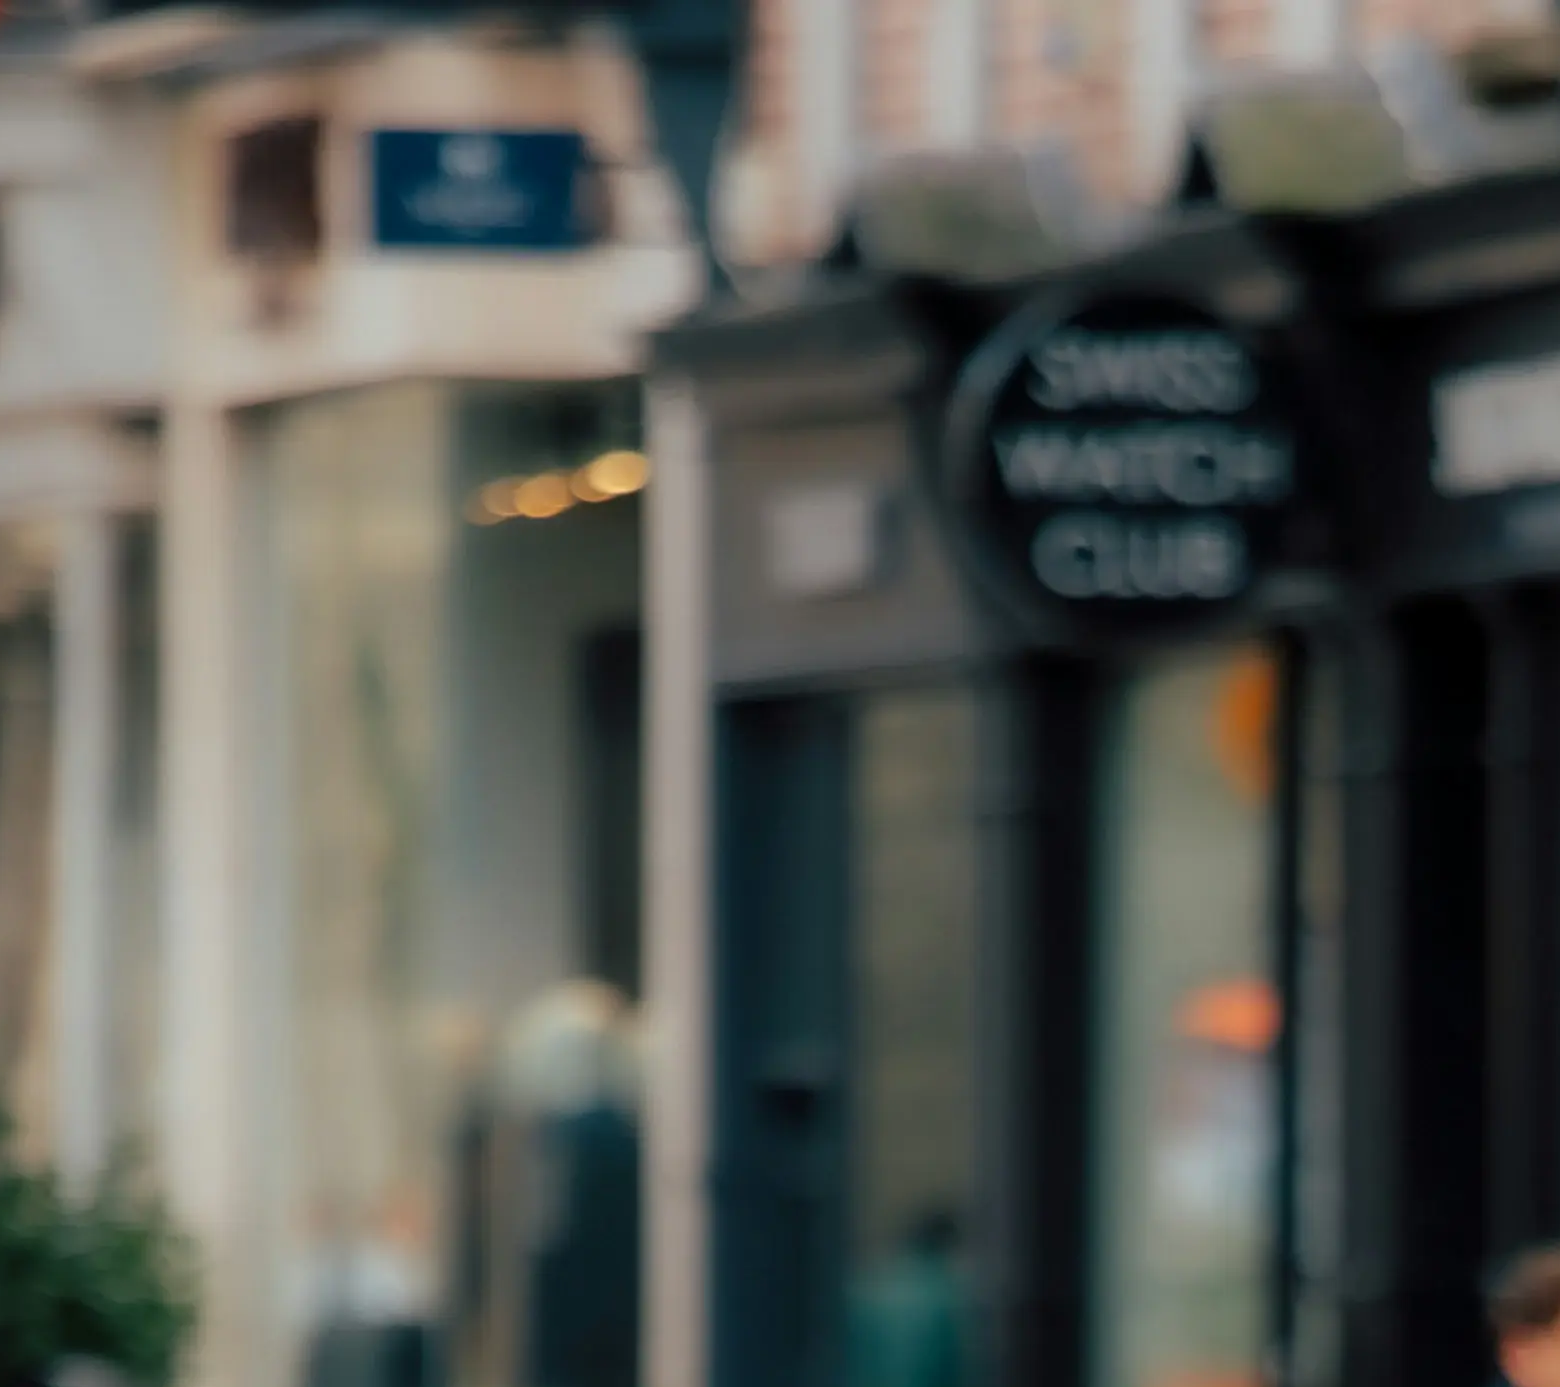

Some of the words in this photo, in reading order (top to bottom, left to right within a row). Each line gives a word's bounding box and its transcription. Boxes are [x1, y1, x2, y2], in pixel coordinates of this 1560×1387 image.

[1032, 330, 1252, 411] SWISS
[995, 425, 1292, 504] WATCH
[1031, 515, 1244, 600] CLUB
